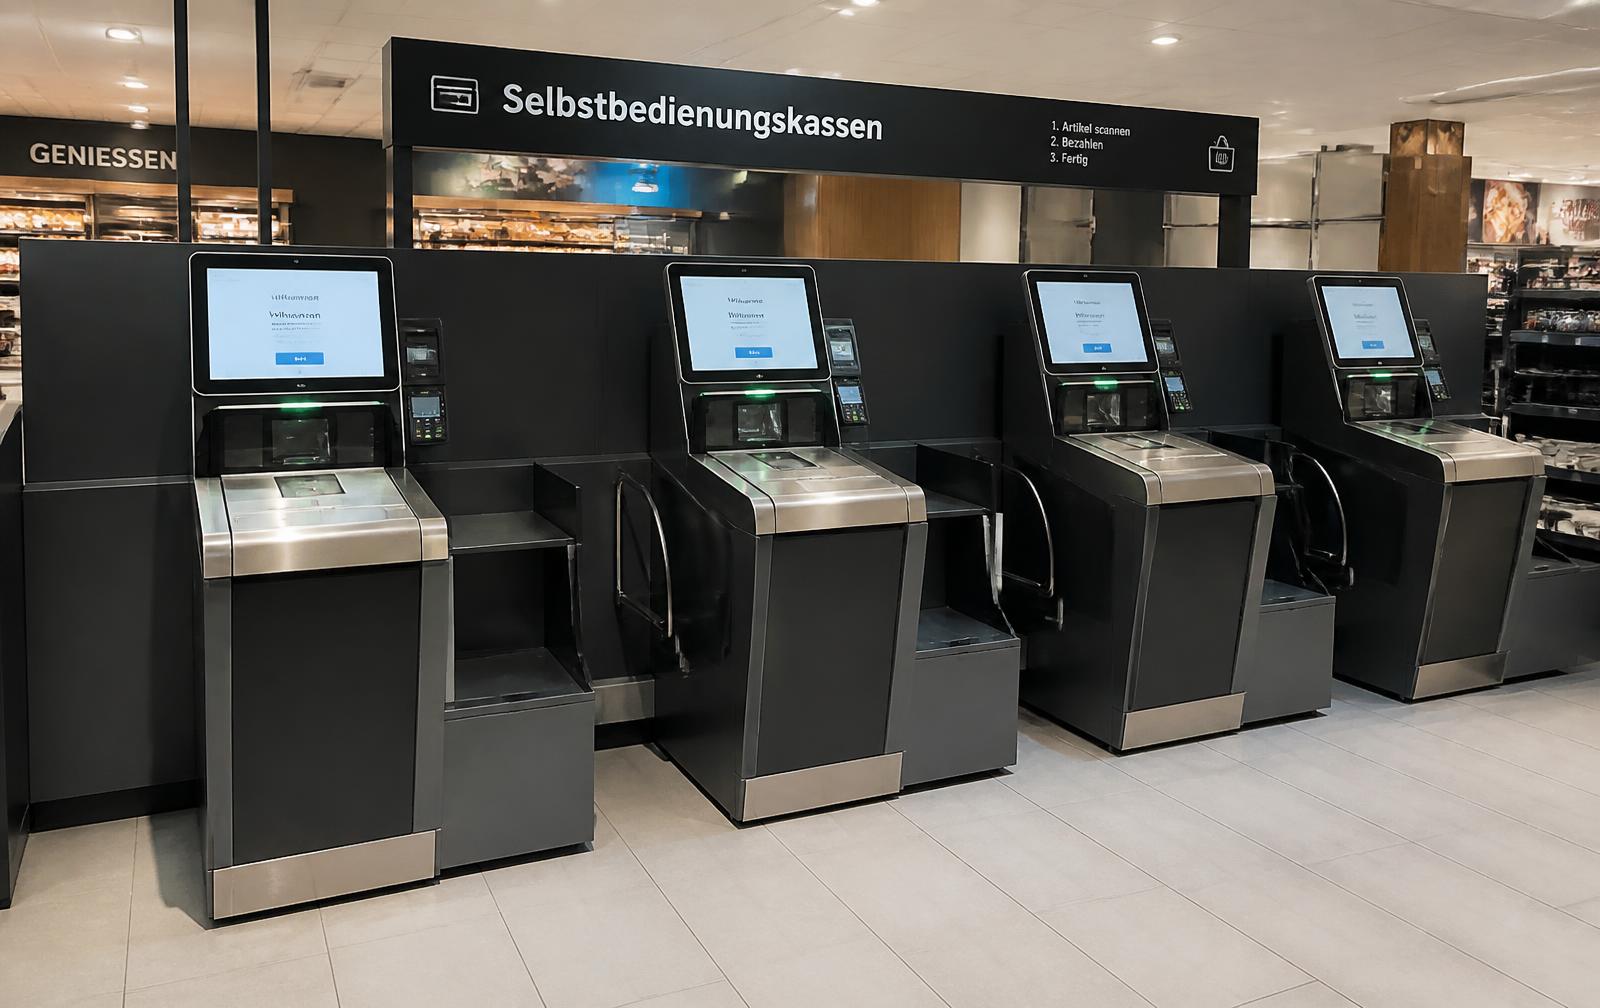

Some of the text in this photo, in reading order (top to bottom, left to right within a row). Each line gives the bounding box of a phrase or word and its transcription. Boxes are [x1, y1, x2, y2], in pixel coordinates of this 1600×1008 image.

[502, 83, 883, 140] Selbstbedienungskassen
[1051, 120, 1131, 136] 1. Artikel scannen
[1050, 136, 1104, 150] 2. Bezahlen
[29, 142, 177, 170] GENIESSEN
[1050, 152, 1089, 167] 3. Fertig
